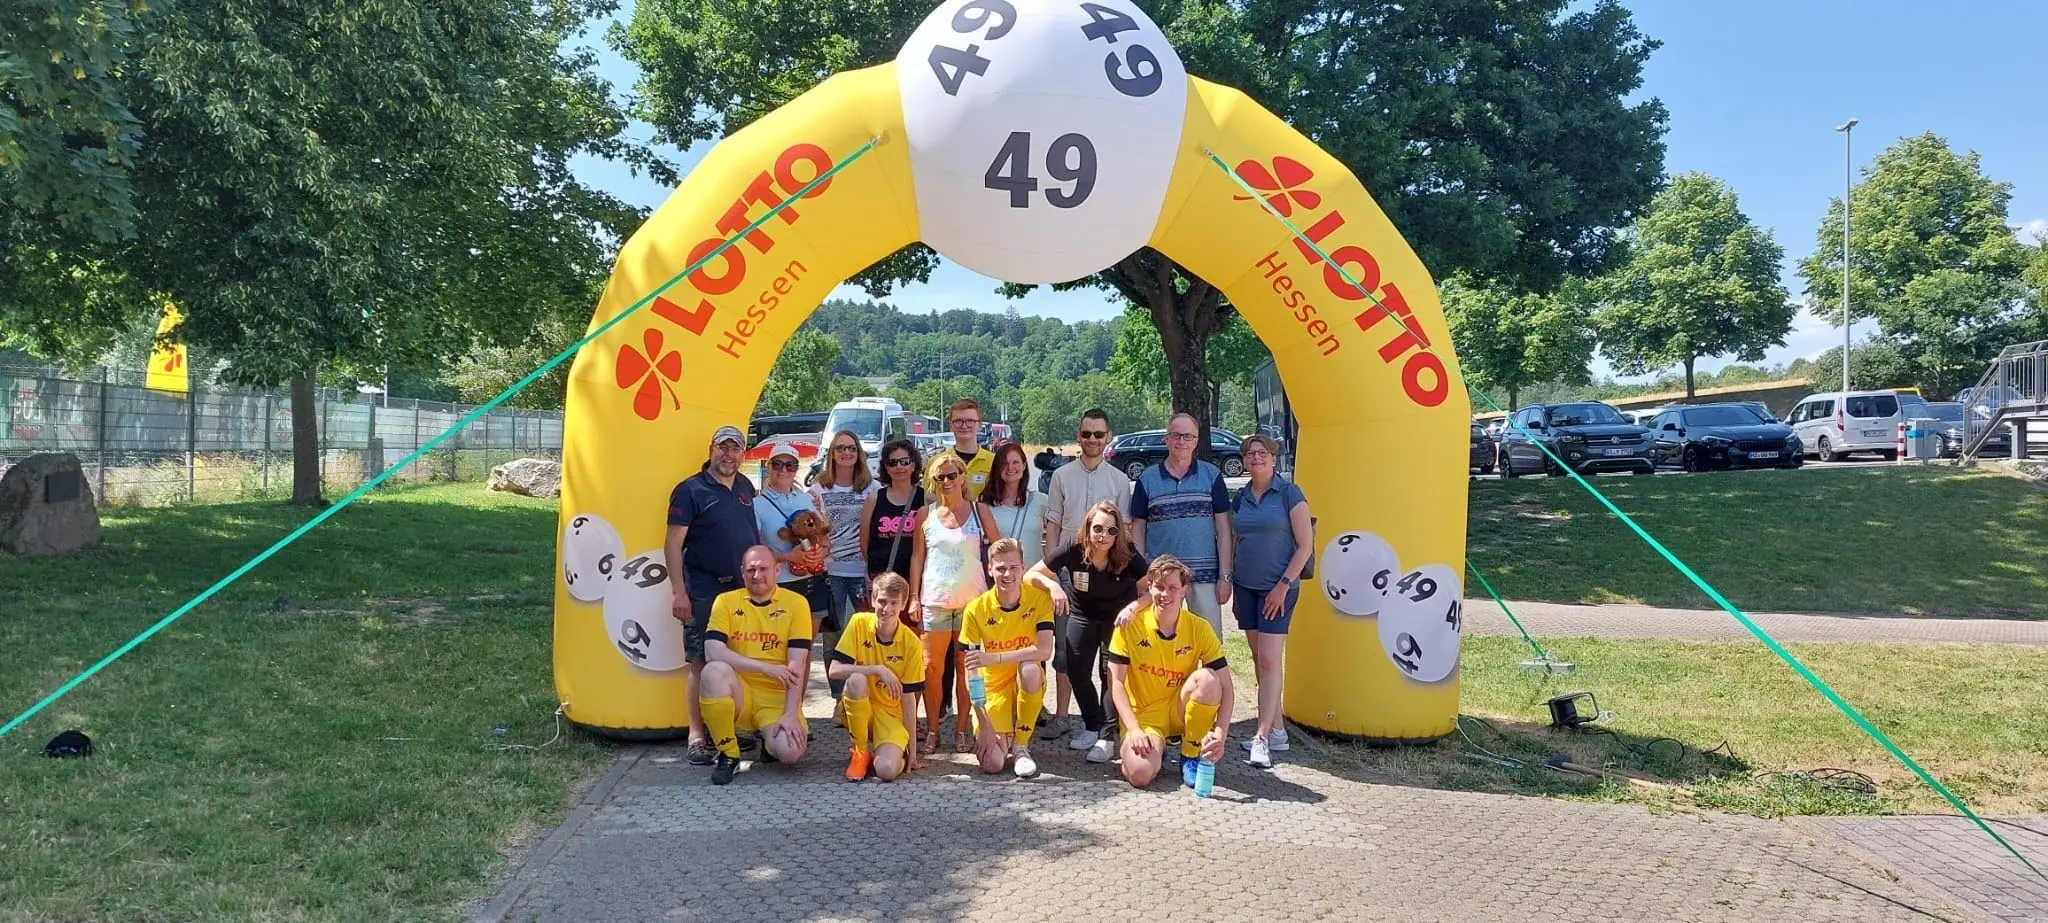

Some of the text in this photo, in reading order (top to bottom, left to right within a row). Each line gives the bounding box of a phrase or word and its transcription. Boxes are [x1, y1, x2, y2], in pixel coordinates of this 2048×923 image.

[928, 0, 1017, 96] 49
[1080, 2, 1163, 97] 49
[984, 131, 1098, 208] 49
[650, 143, 834, 336] LOTTO
[716, 259, 808, 358] Hessen
[1256, 251, 1341, 357] Hessen
[1293, 210, 1449, 407] LOTTO
[620, 556, 668, 589] 49
[1396, 571, 1437, 603] 49
[618, 619, 651, 664] 49
[744, 632, 778, 642] LOTTO
[999, 636, 1030, 649] LOTTO
[1393, 632, 1422, 676] 49
[1151, 665, 1185, 680] LOTTO
